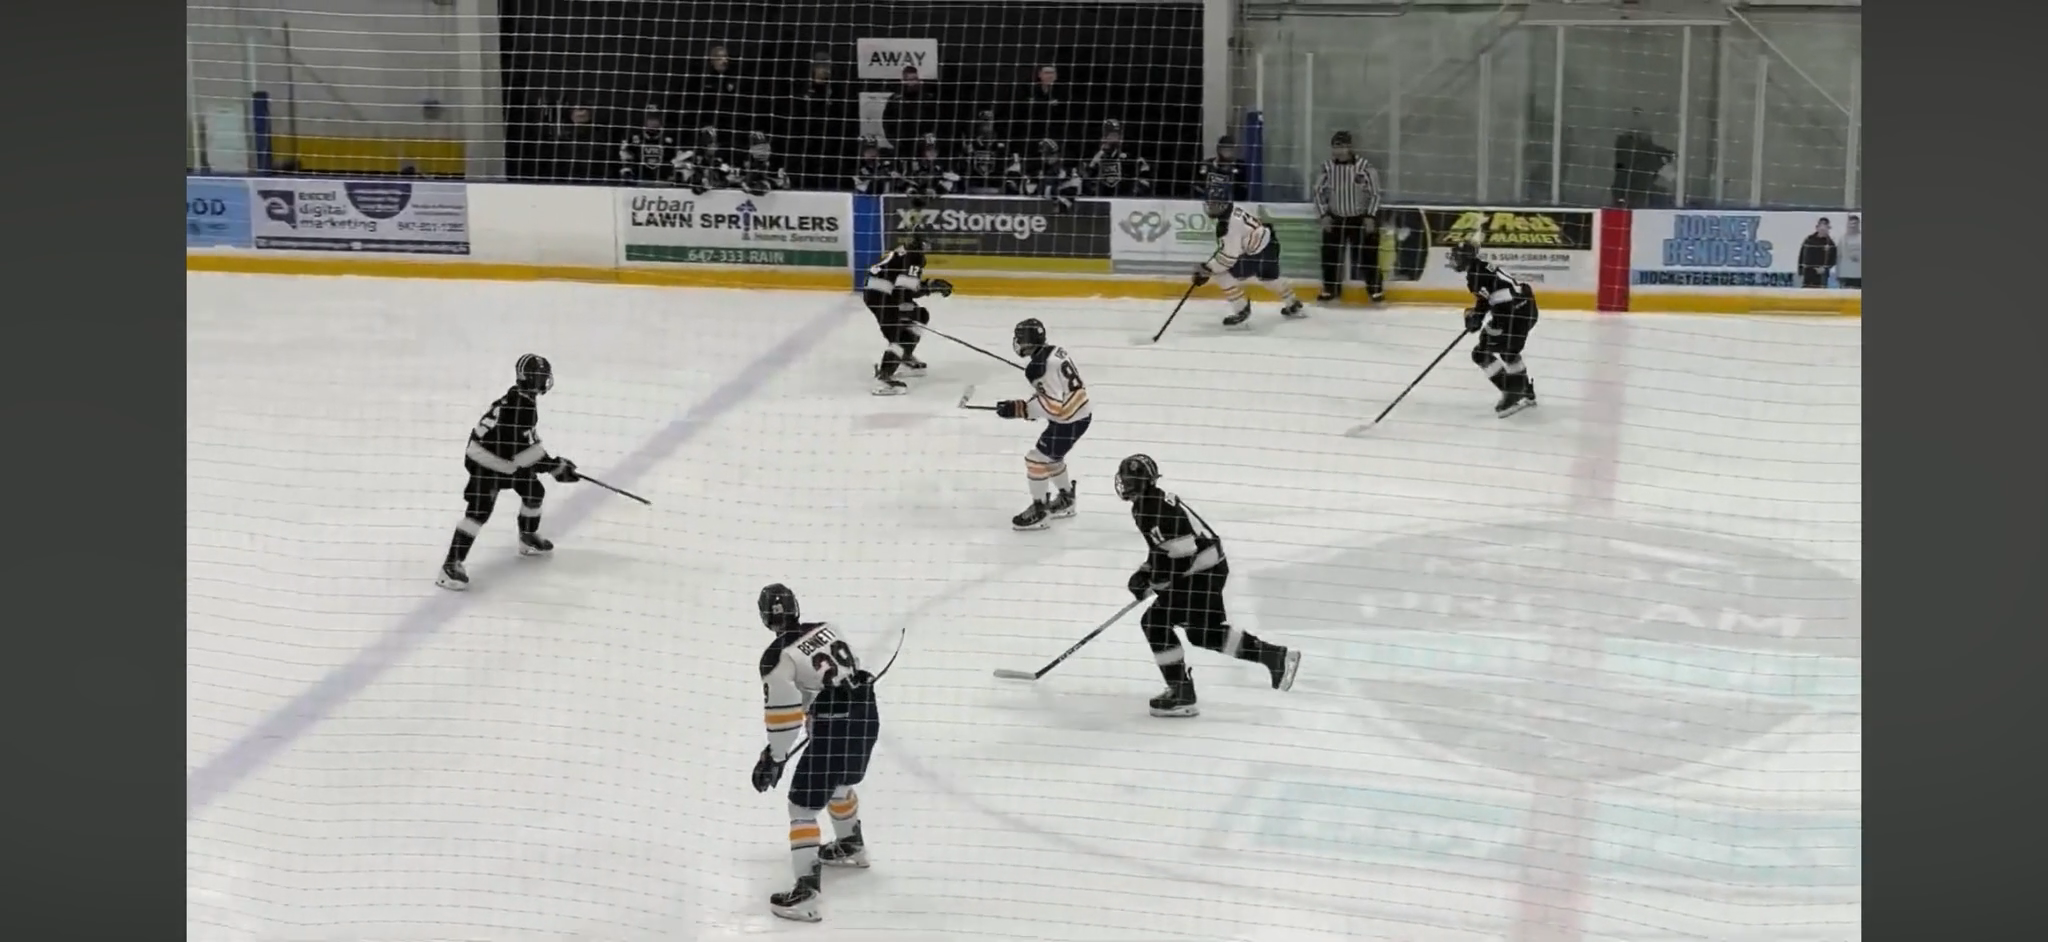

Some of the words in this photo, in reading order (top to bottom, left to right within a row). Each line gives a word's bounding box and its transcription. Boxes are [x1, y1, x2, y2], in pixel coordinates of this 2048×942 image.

[868, 51, 926, 67] AWAY
[298, 203, 348, 218] digital
[631, 195, 695, 212] Urban
[299, 218, 378, 232] marketing
[631, 212, 694, 228] LAWN
[700, 212, 840, 232] SPRINKLERS
[1673, 214, 1762, 240] HOCKEY
[1488, 232, 1562, 245] MARKET
[749, 250, 785, 263] RAIN
[1662, 238, 1774, 268] BENDERS
[908, 264, 921, 277] 12
[797, 628, 836, 657] BENNETT
[811, 639, 858, 687] 29
